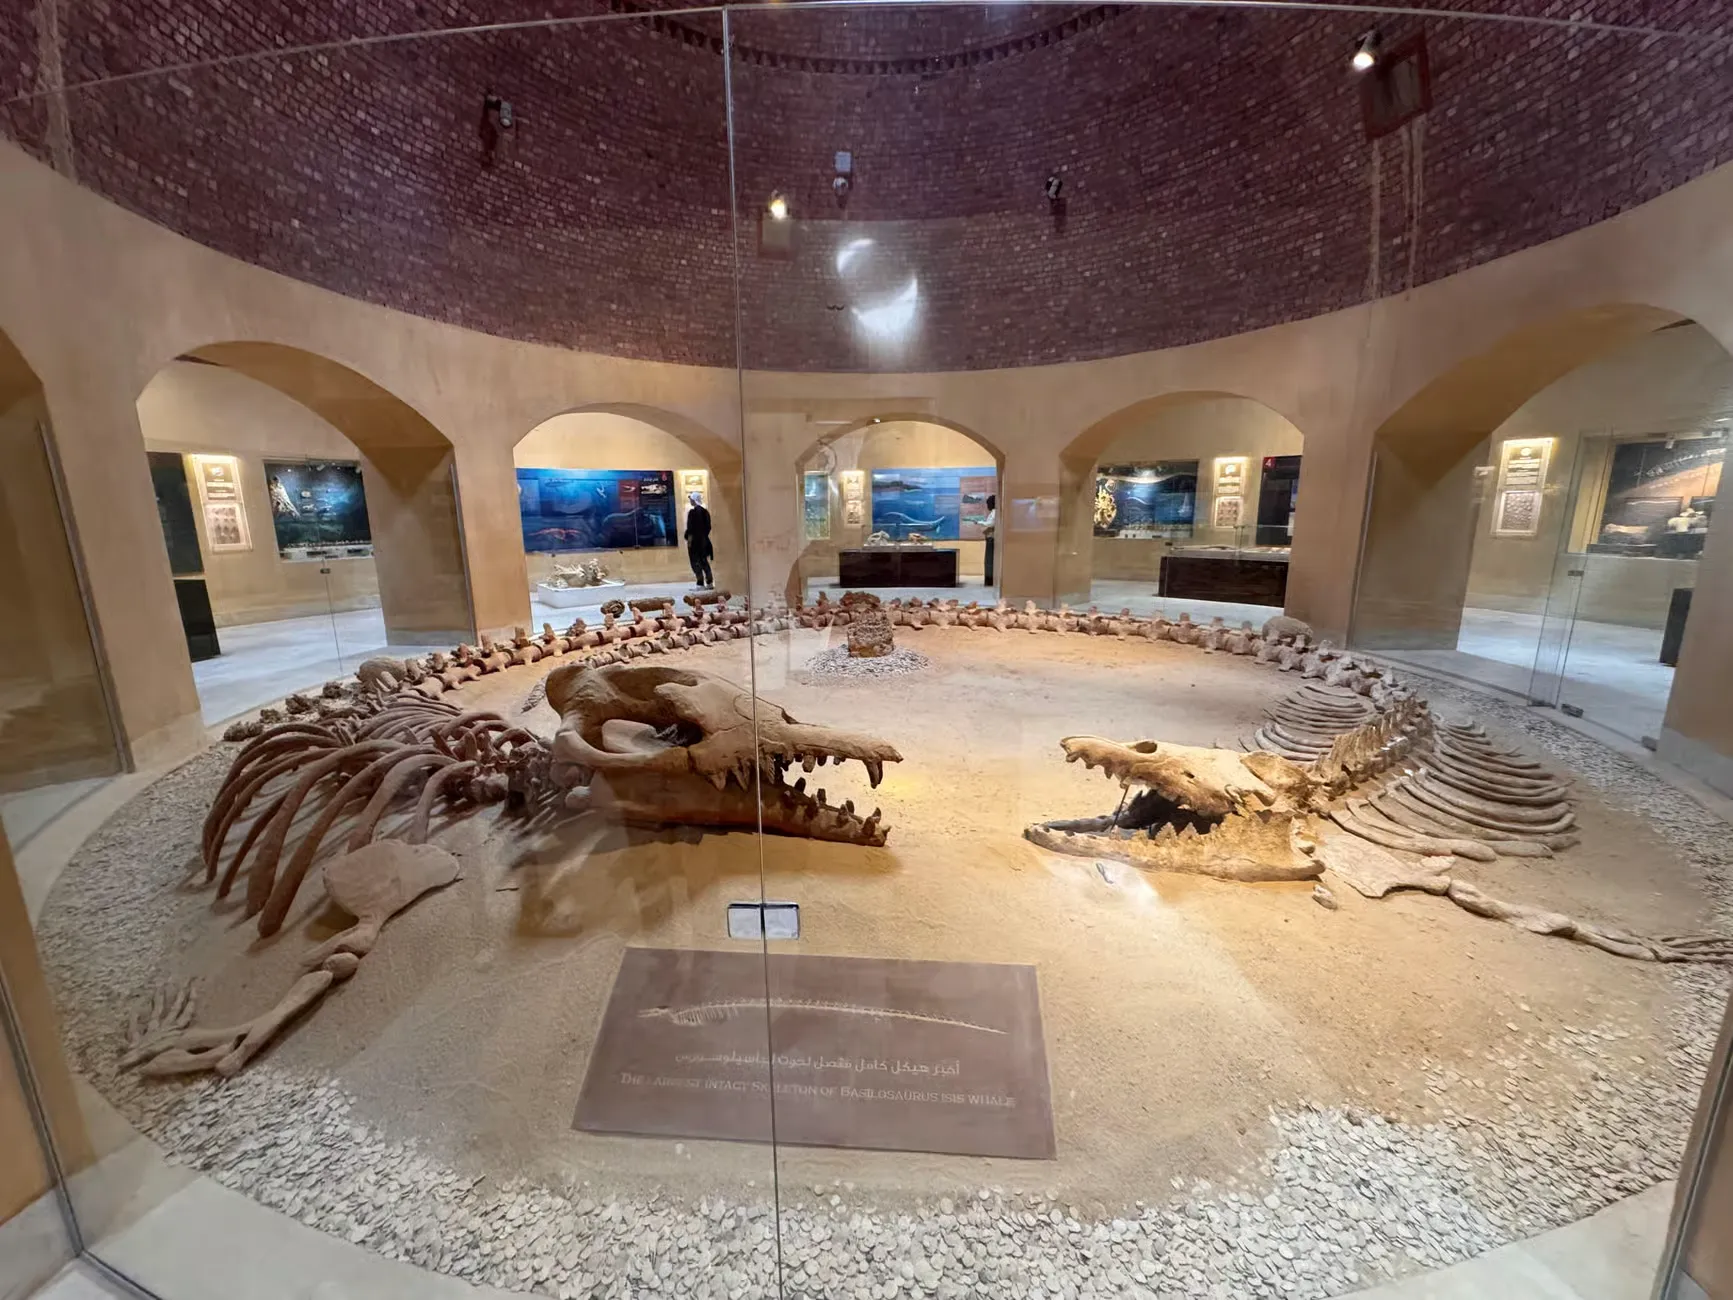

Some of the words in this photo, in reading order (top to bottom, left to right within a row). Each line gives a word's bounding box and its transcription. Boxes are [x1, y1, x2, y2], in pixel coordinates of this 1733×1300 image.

[855, 1058, 888, 1073] كامل
[890, 1059, 929, 1076] هيكل
[704, 1077, 748, 1092] INTACT
[820, 1086, 838, 1096] OF
[840, 1086, 938, 1103] BASILOSAURUS
[941, 1092, 965, 1105] ISIS
[967, 1094, 1017, 1109] WHALE
